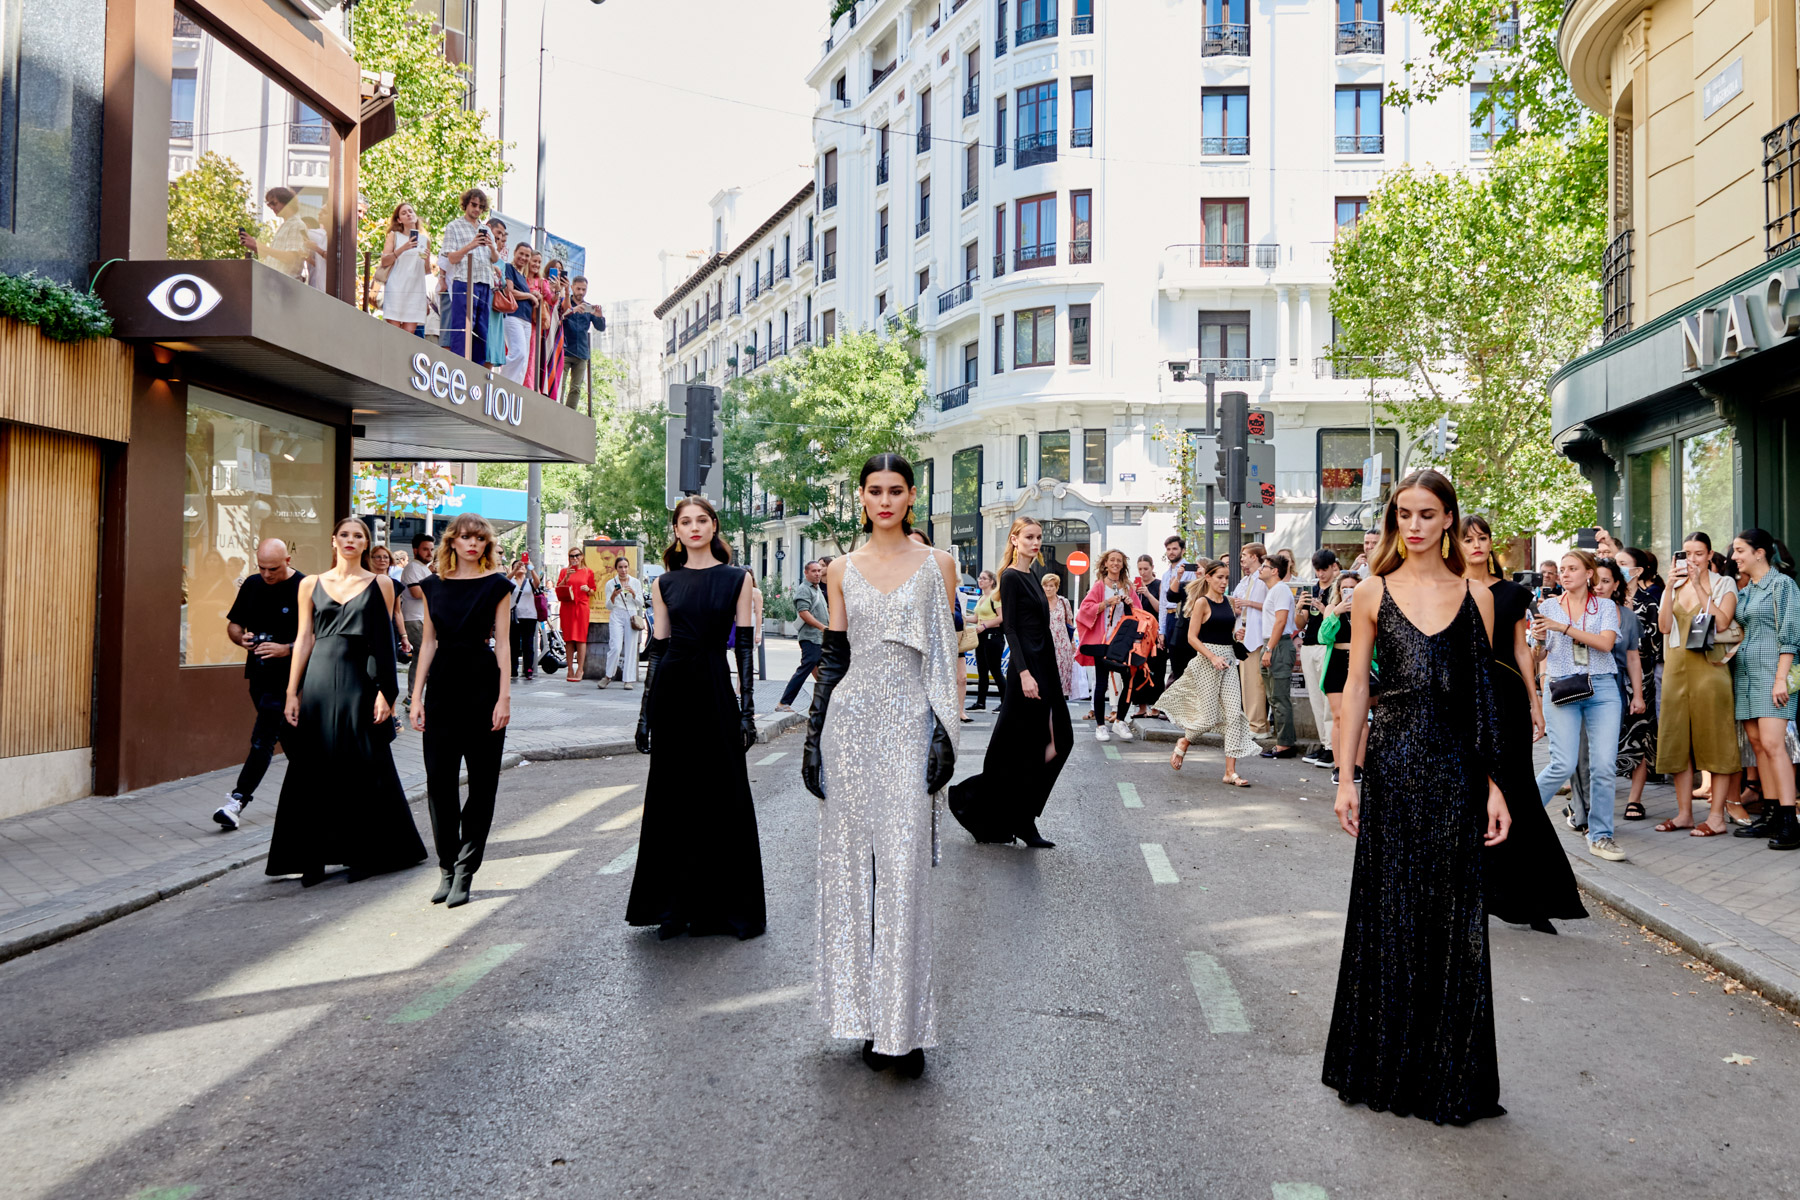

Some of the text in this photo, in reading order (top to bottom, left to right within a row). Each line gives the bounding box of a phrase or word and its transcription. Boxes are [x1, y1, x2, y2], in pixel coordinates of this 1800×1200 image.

[1677, 267, 1800, 373] NAC
[411, 352, 523, 426] see iou
